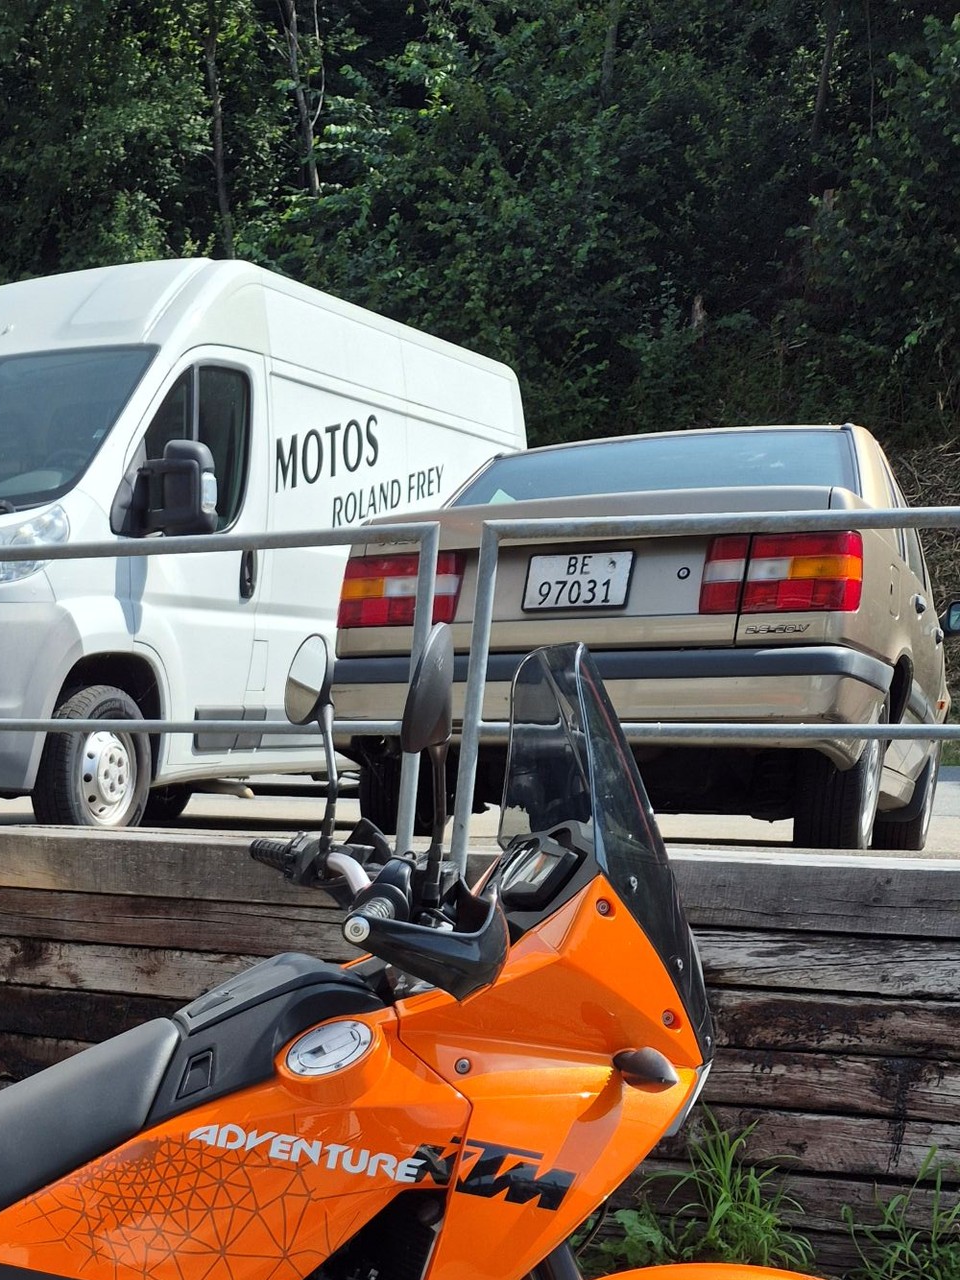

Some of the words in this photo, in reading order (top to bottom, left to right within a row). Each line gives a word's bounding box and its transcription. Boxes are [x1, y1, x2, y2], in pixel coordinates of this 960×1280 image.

[275, 414, 379, 493] MOTOS
[332, 478, 402, 528] ROLAND
[407, 463, 445, 503] FREY
[538, 579, 612, 605] 97031
[566, 555, 593, 576] BE
[189, 1123, 427, 1183] ADVENTURE
[415, 1135, 578, 1211] KTM
